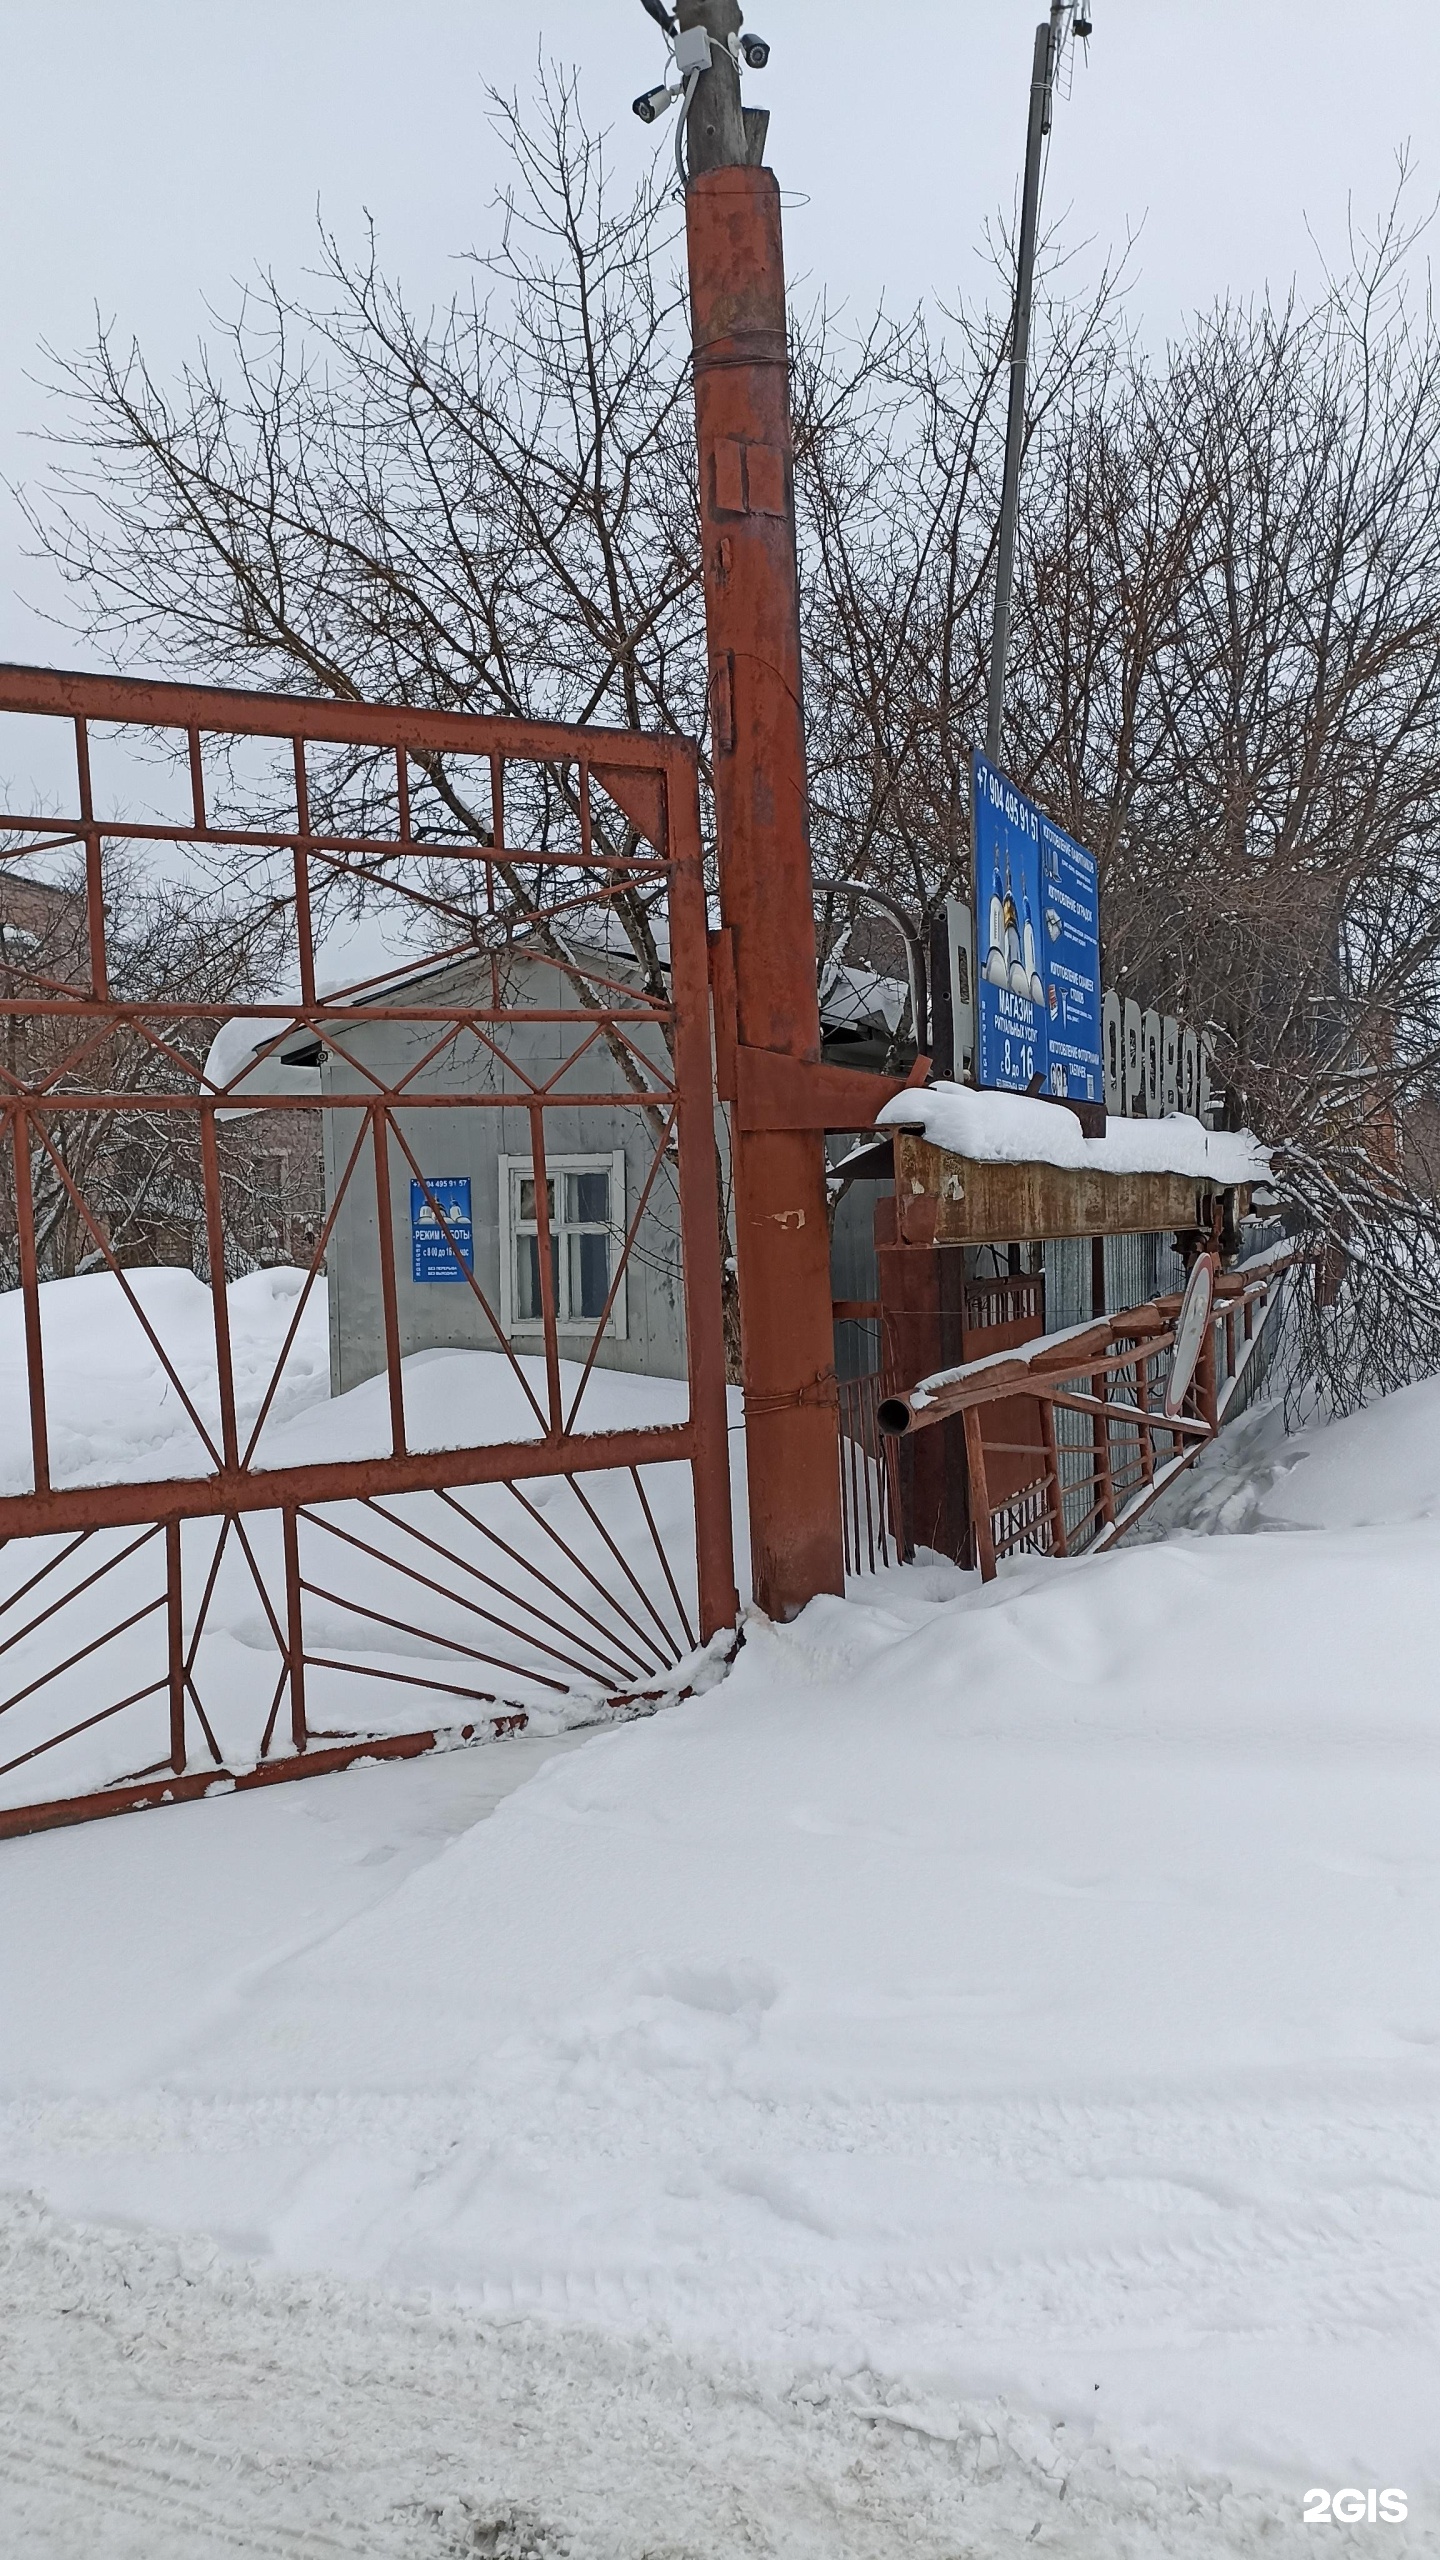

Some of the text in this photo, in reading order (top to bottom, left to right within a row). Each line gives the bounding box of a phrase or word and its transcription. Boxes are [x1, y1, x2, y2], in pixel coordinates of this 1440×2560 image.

[977, 766, 1039, 842] +7 904 495 91 57
[999, 988, 1034, 1025] МАГАЗИН
[994, 1014, 1024, 1039] РИТУАЛЬНЫХ
[1004, 1039, 1011, 1075] 8
[1020, 1044, 1034, 1081] 16
[435, 1180, 447, 1188] 495
[448, 1179, 457, 1187] 91
[458, 1179, 467, 1187] 57
[415, 1229, 470, 1240] РЕЖИМ РБОТЫ
